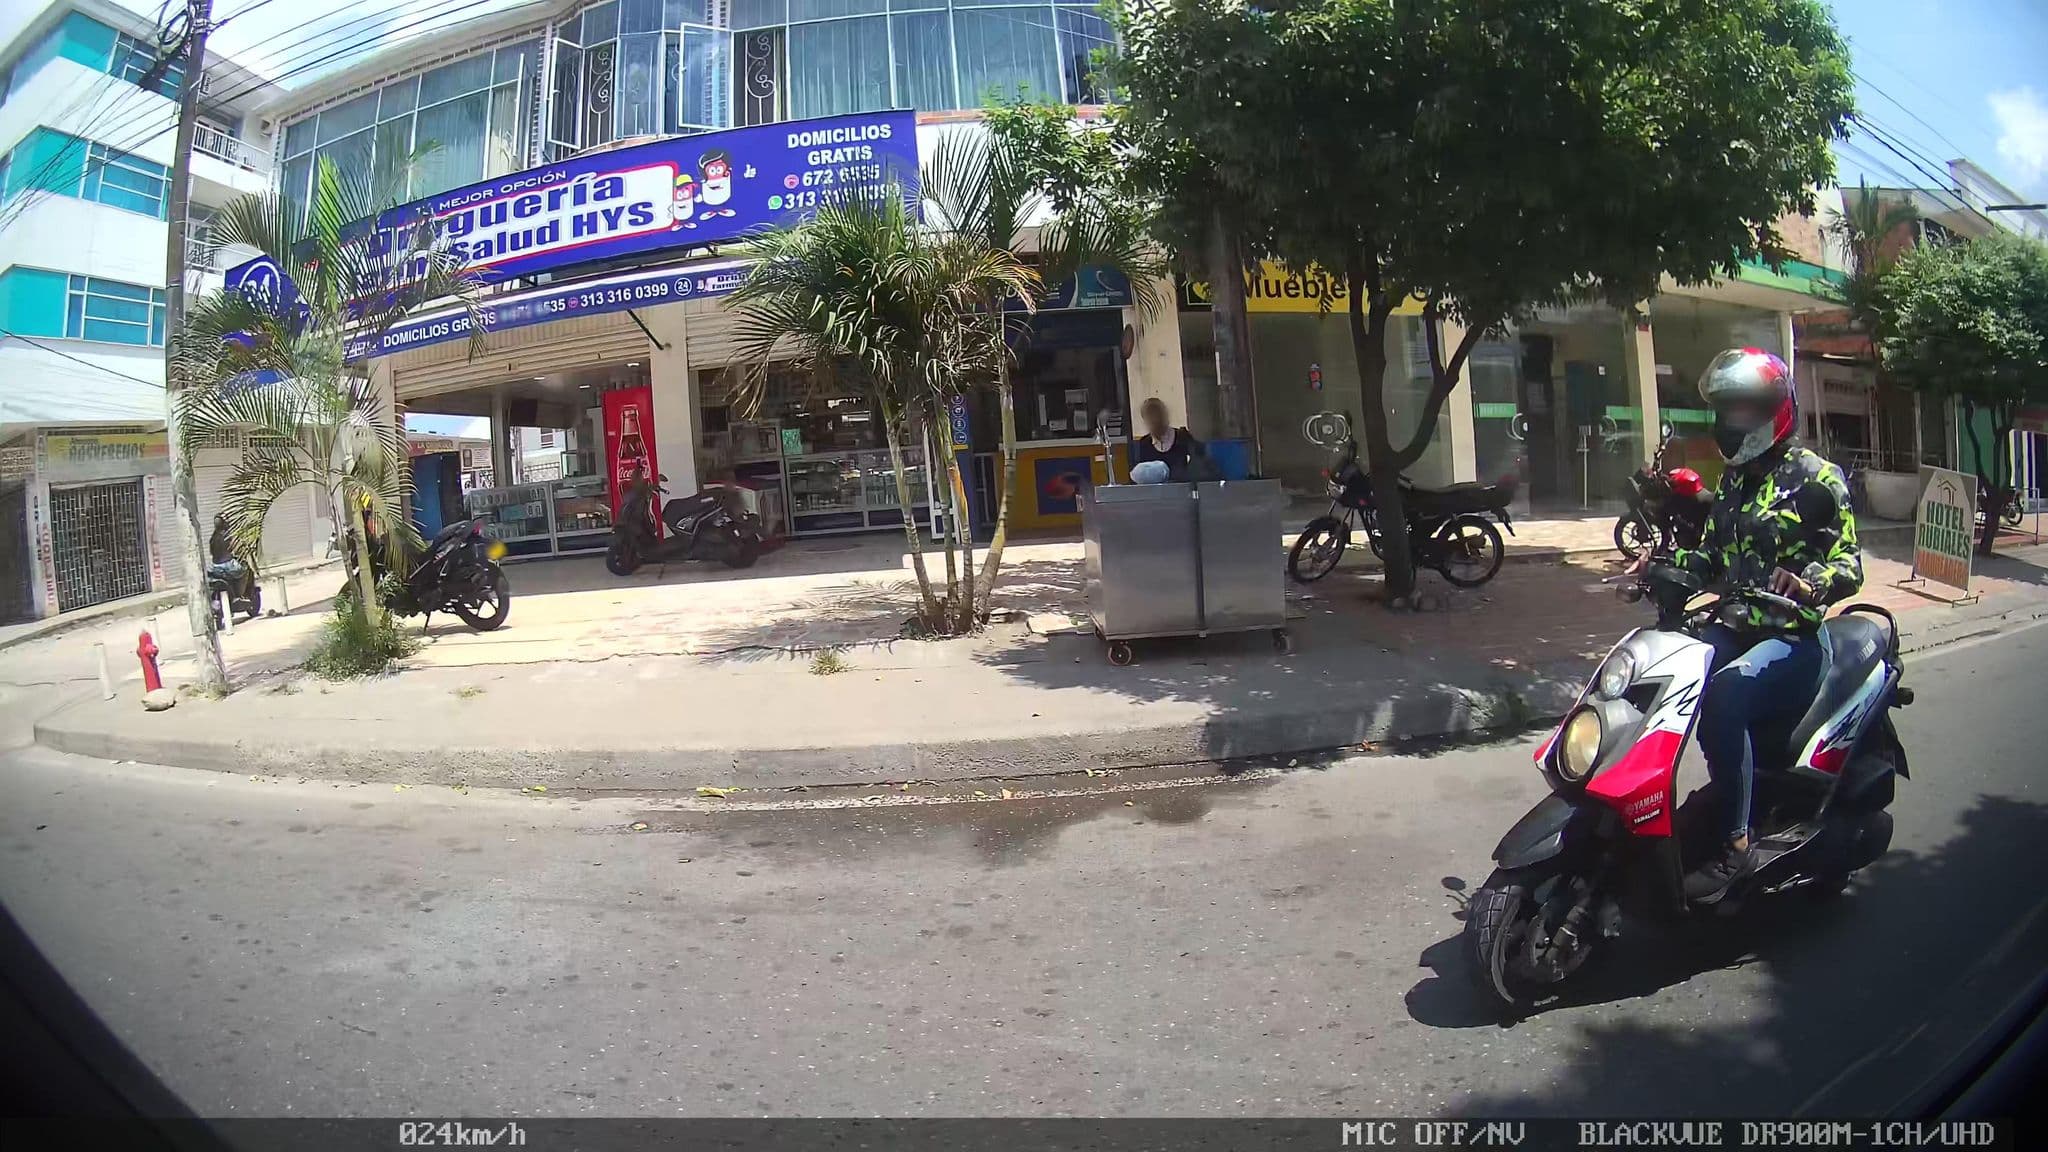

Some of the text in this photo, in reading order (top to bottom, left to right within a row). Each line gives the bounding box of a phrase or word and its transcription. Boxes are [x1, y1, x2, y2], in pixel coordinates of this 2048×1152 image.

[787, 124, 892, 149] DOMICILIOS
[807, 145, 873, 166] GRATIS
[802, 168, 834, 187] 672
[439, 189, 494, 212] MEJOR
[500, 170, 567, 195] OPCIÓN
[784, 190, 817, 210] 313
[450, 201, 655, 262] Salud HYS
[1248, 275, 1348, 300] Mueble
[383, 322, 450, 348] DOMICILIOS
[451, 312, 497, 332] GRTIS
[580, 288, 604, 308] 313
[607, 284, 632, 305] 316
[635, 282, 669, 301] 0399
[677, 280, 689, 291] 24
[1927, 501, 1965, 531] HOTEL
[1918, 522, 1971, 559] RUBIALES
[1633, 789, 1664, 812] YAMAHA
